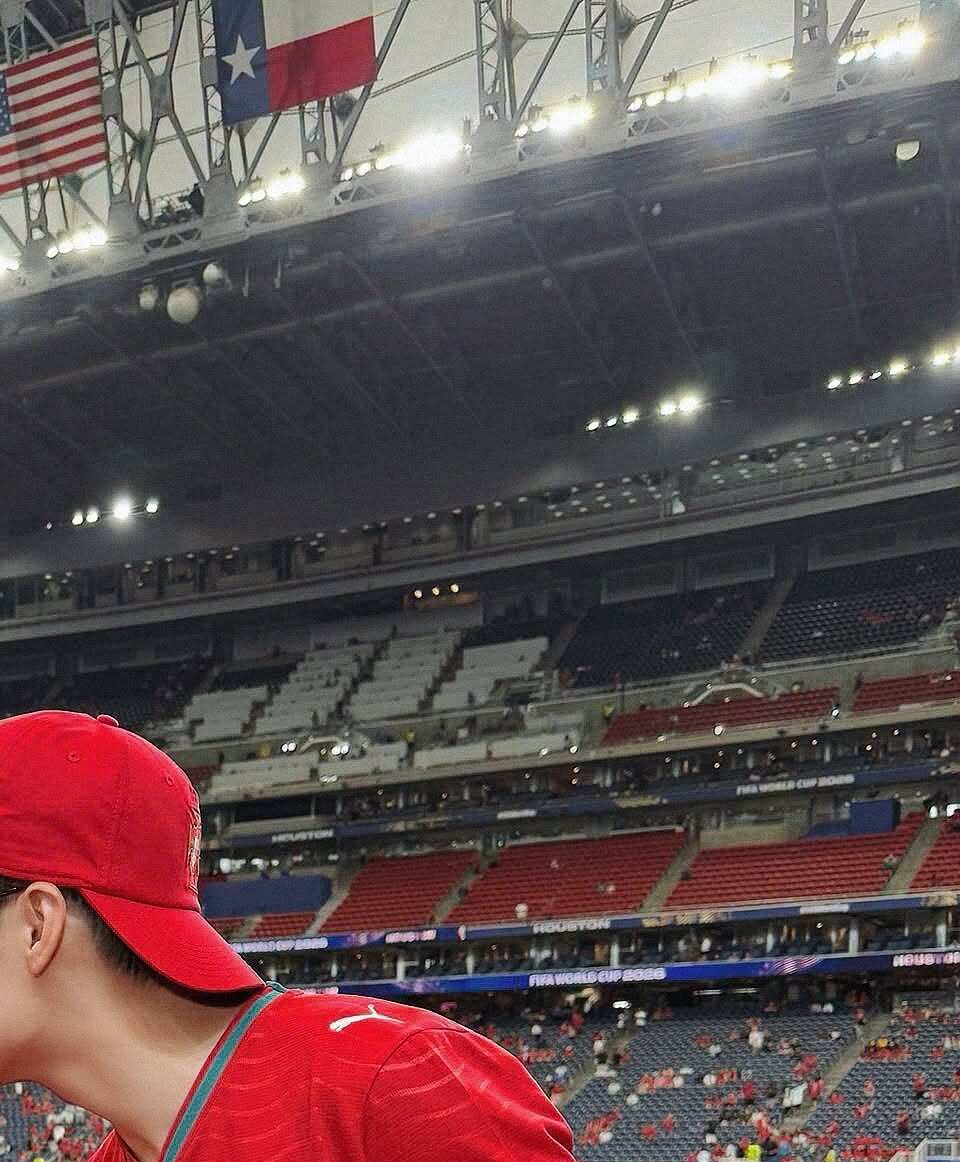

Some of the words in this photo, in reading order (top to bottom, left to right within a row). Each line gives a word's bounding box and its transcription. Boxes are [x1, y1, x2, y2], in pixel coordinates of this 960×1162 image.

[532, 918, 610, 934] HOUSTON
[529, 973, 555, 987] FIFA
[554, 970, 597, 986] WORLD
[597, 969, 622, 982] CUP
